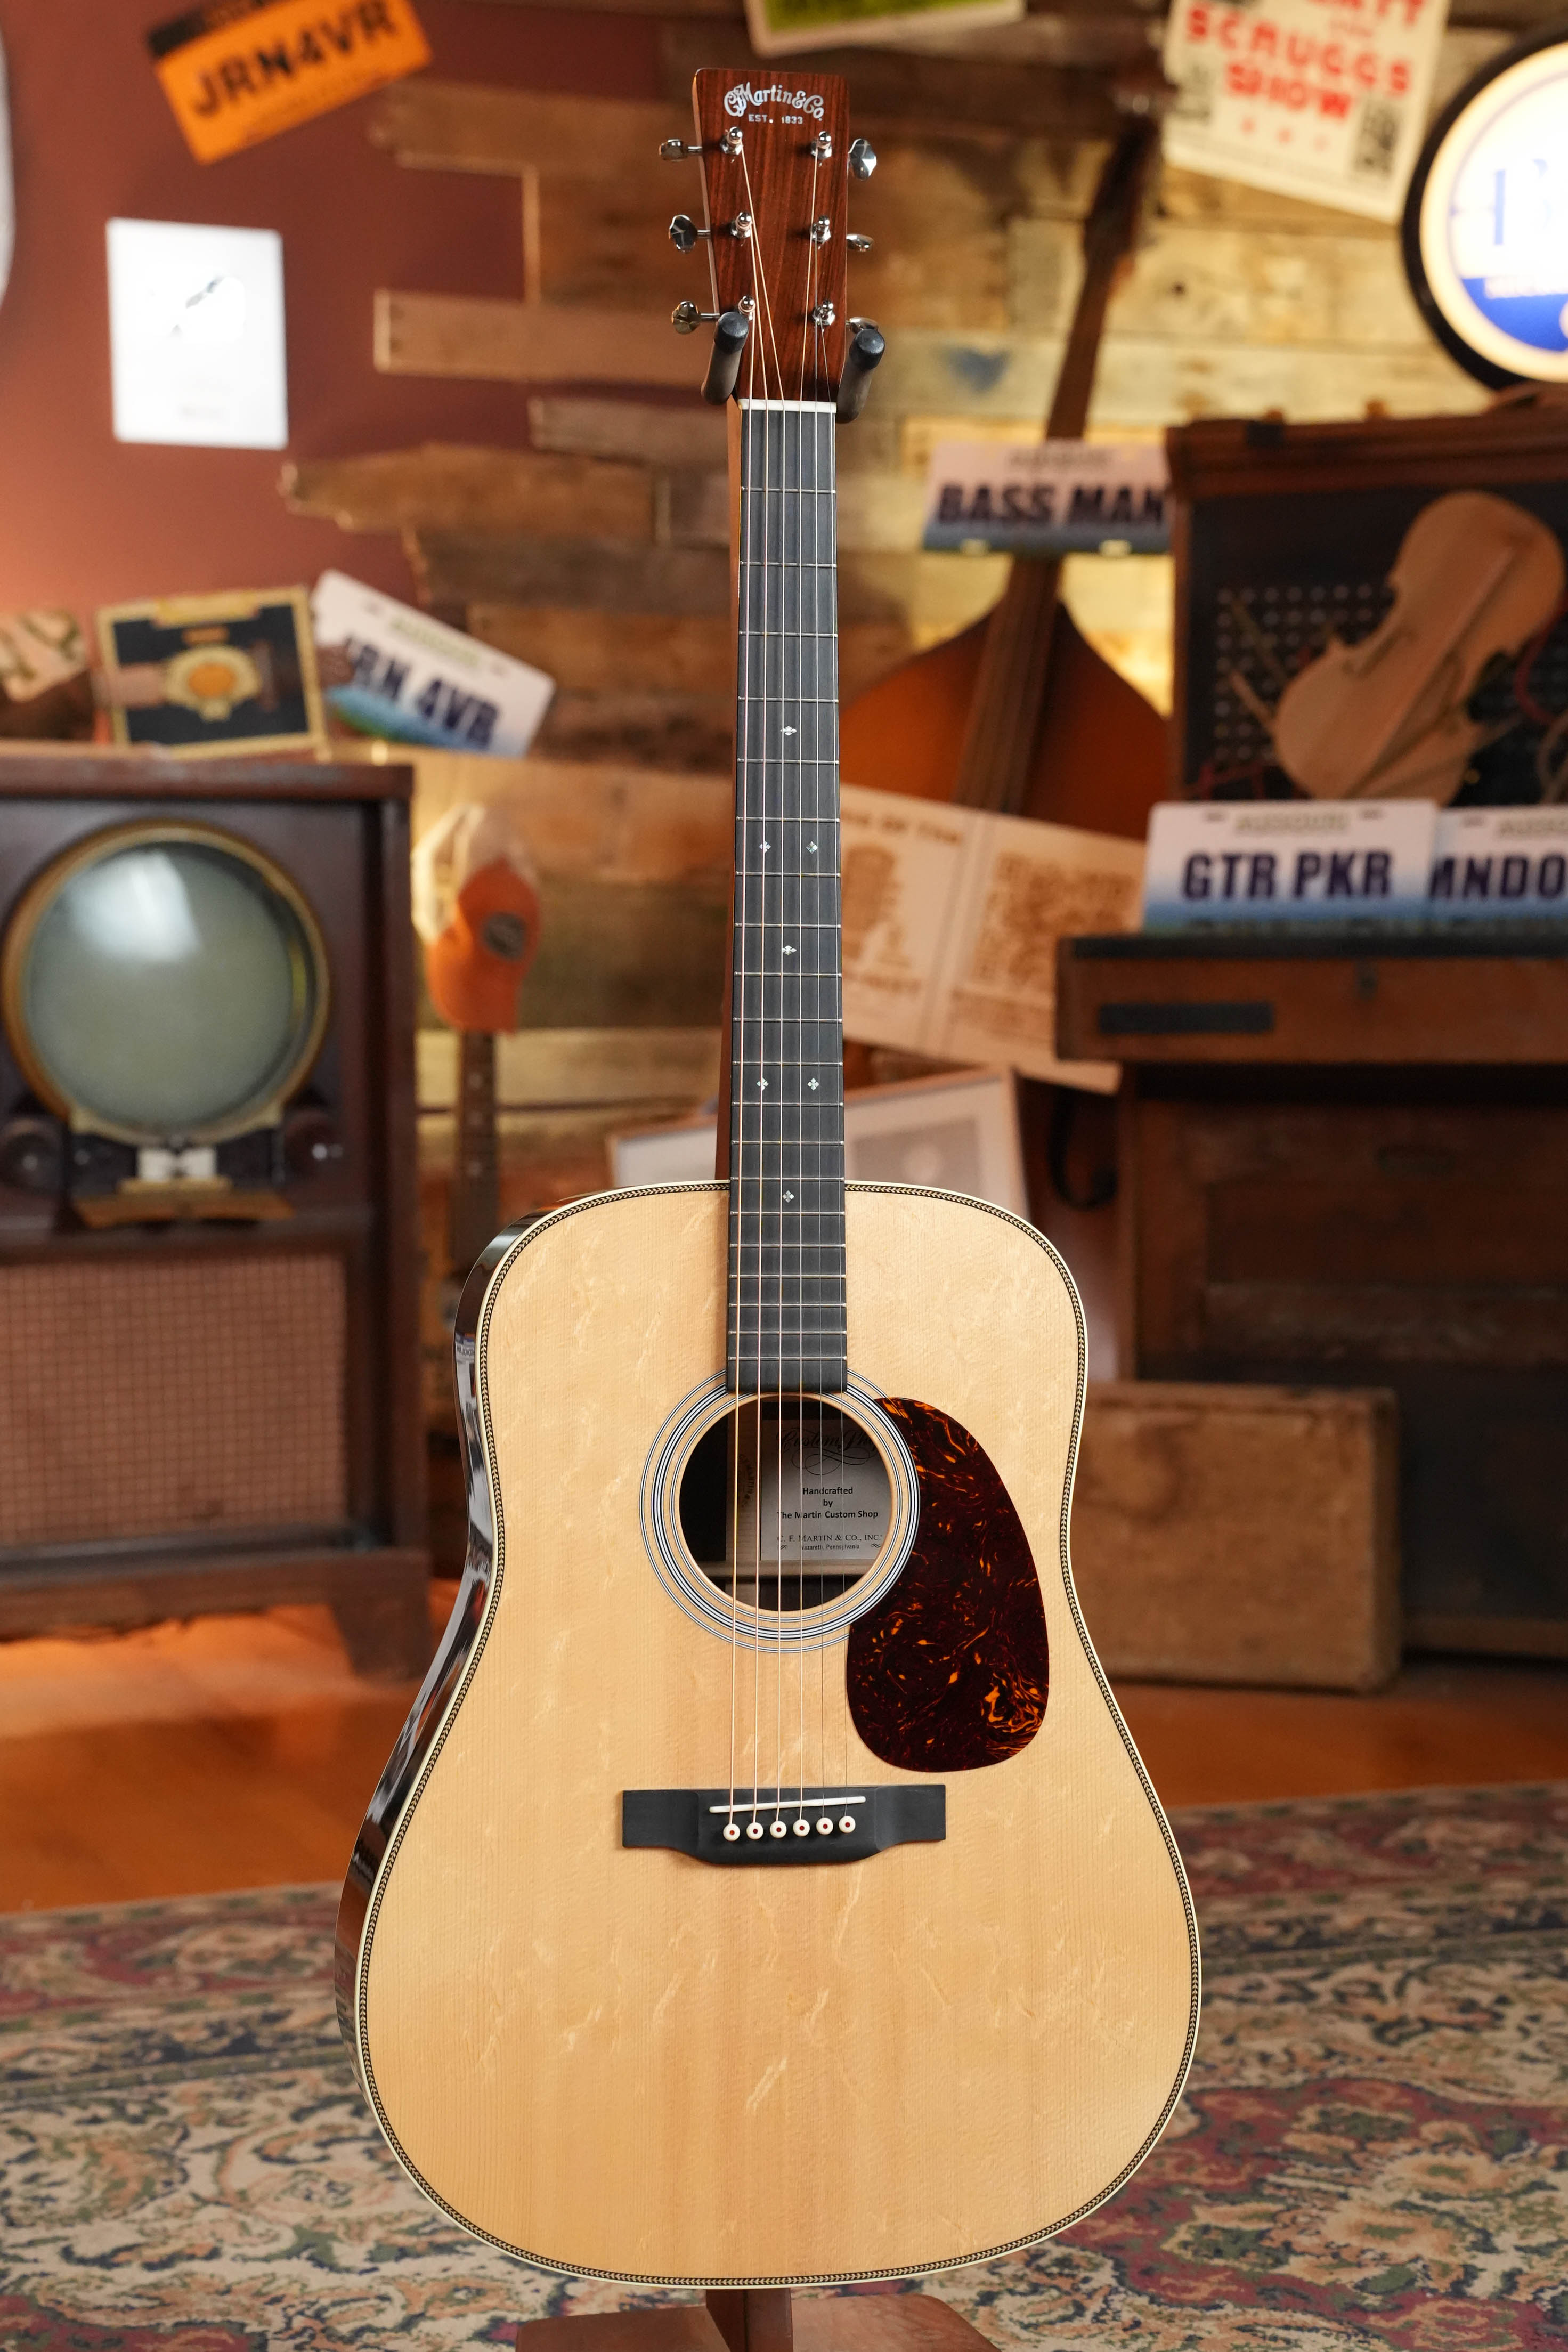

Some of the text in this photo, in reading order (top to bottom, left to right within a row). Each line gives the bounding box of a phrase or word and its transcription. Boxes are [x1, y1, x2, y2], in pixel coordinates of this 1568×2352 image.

[748, 113, 803, 125] EST. 1833
[1182, 849, 1392, 901] GTR PKR
[803, 1486, 853, 1495] Handcrafted
[823, 1499, 833, 1507] by
[857, 1510, 879, 1519] Shop
